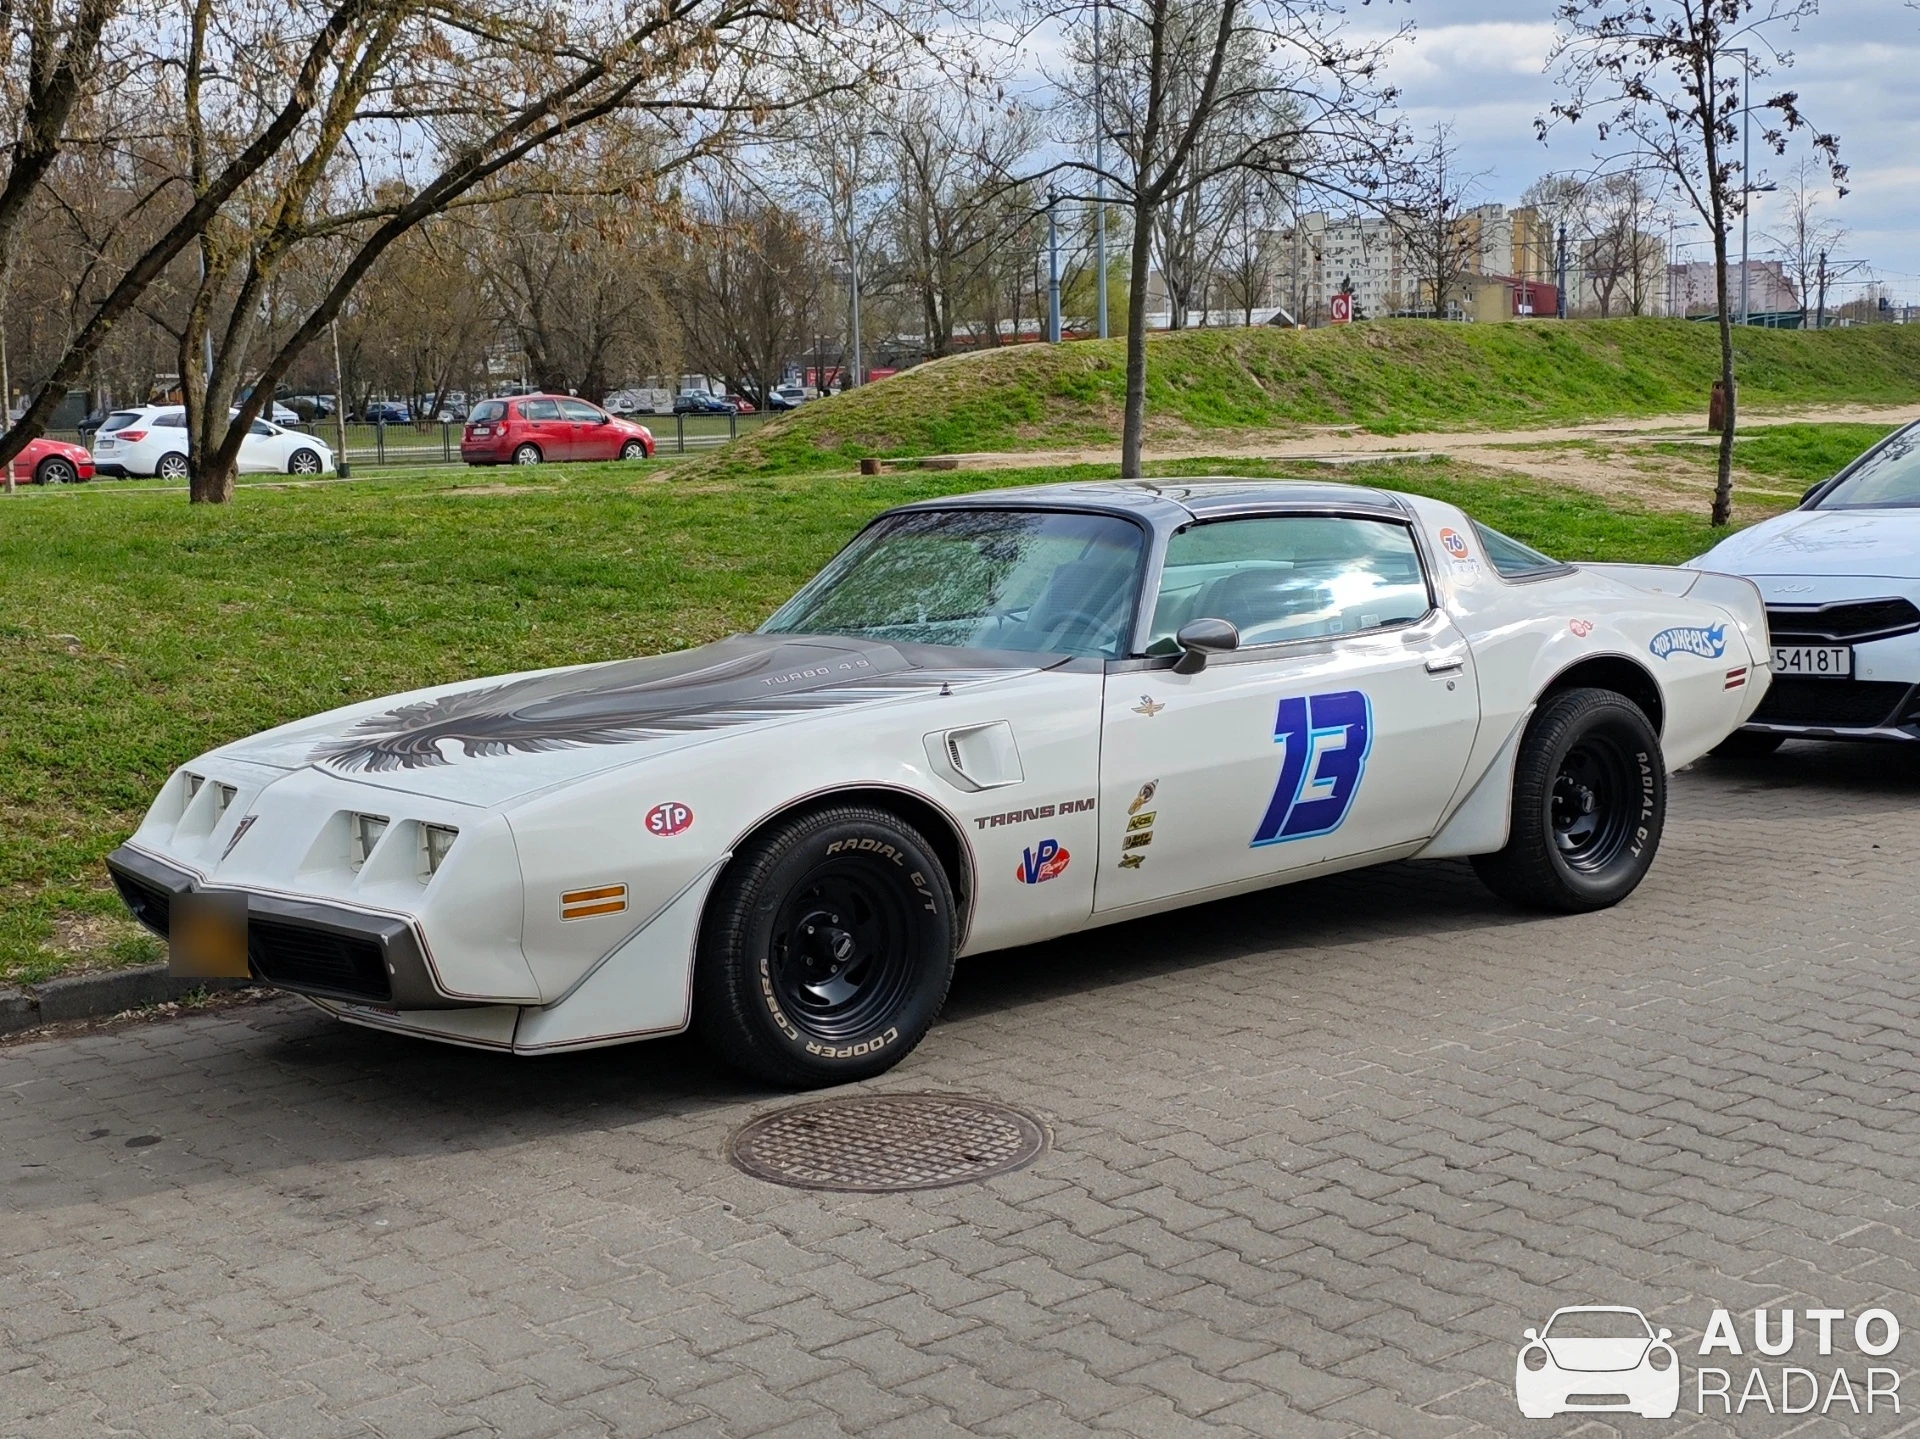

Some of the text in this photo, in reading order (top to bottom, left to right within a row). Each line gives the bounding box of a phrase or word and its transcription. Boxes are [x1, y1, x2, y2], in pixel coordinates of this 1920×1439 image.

[1443, 533, 1465, 553] 76
[760, 666, 832, 687] TURBO
[1776, 648, 1844, 672] 5418T
[1250, 690, 1374, 848] 13
[1634, 751, 1655, 822] RADIAL
[650, 803, 687, 831] STP
[973, 797, 1096, 830] TRANS AM
[825, 836, 939, 917] RADIAL G/T
[1022, 838, 1060, 885] VP
[758, 957, 899, 1060] COOPER COBRA
